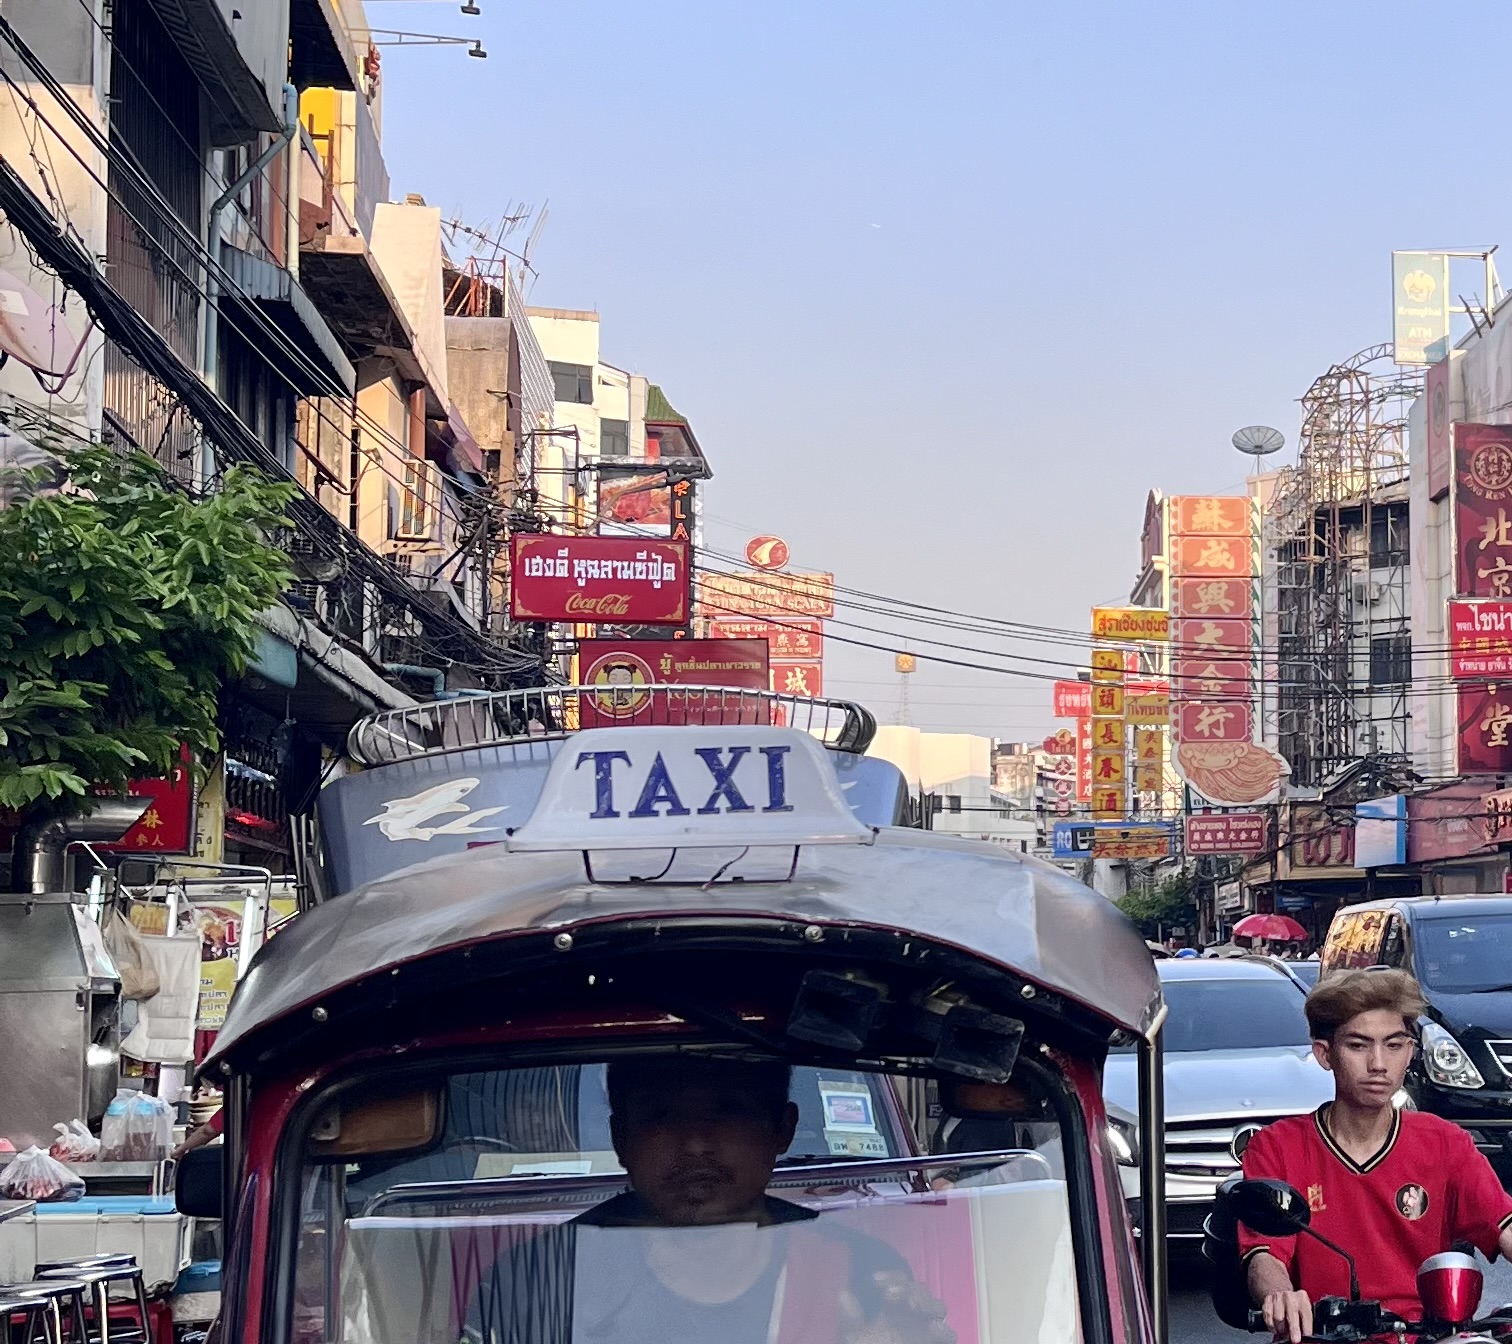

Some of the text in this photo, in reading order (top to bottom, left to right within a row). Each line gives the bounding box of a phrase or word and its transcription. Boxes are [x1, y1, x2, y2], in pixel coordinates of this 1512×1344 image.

[1485, 489, 1506, 500] REN
[787, 596, 827, 611] SCALA
[576, 745, 793, 819] TAXI
